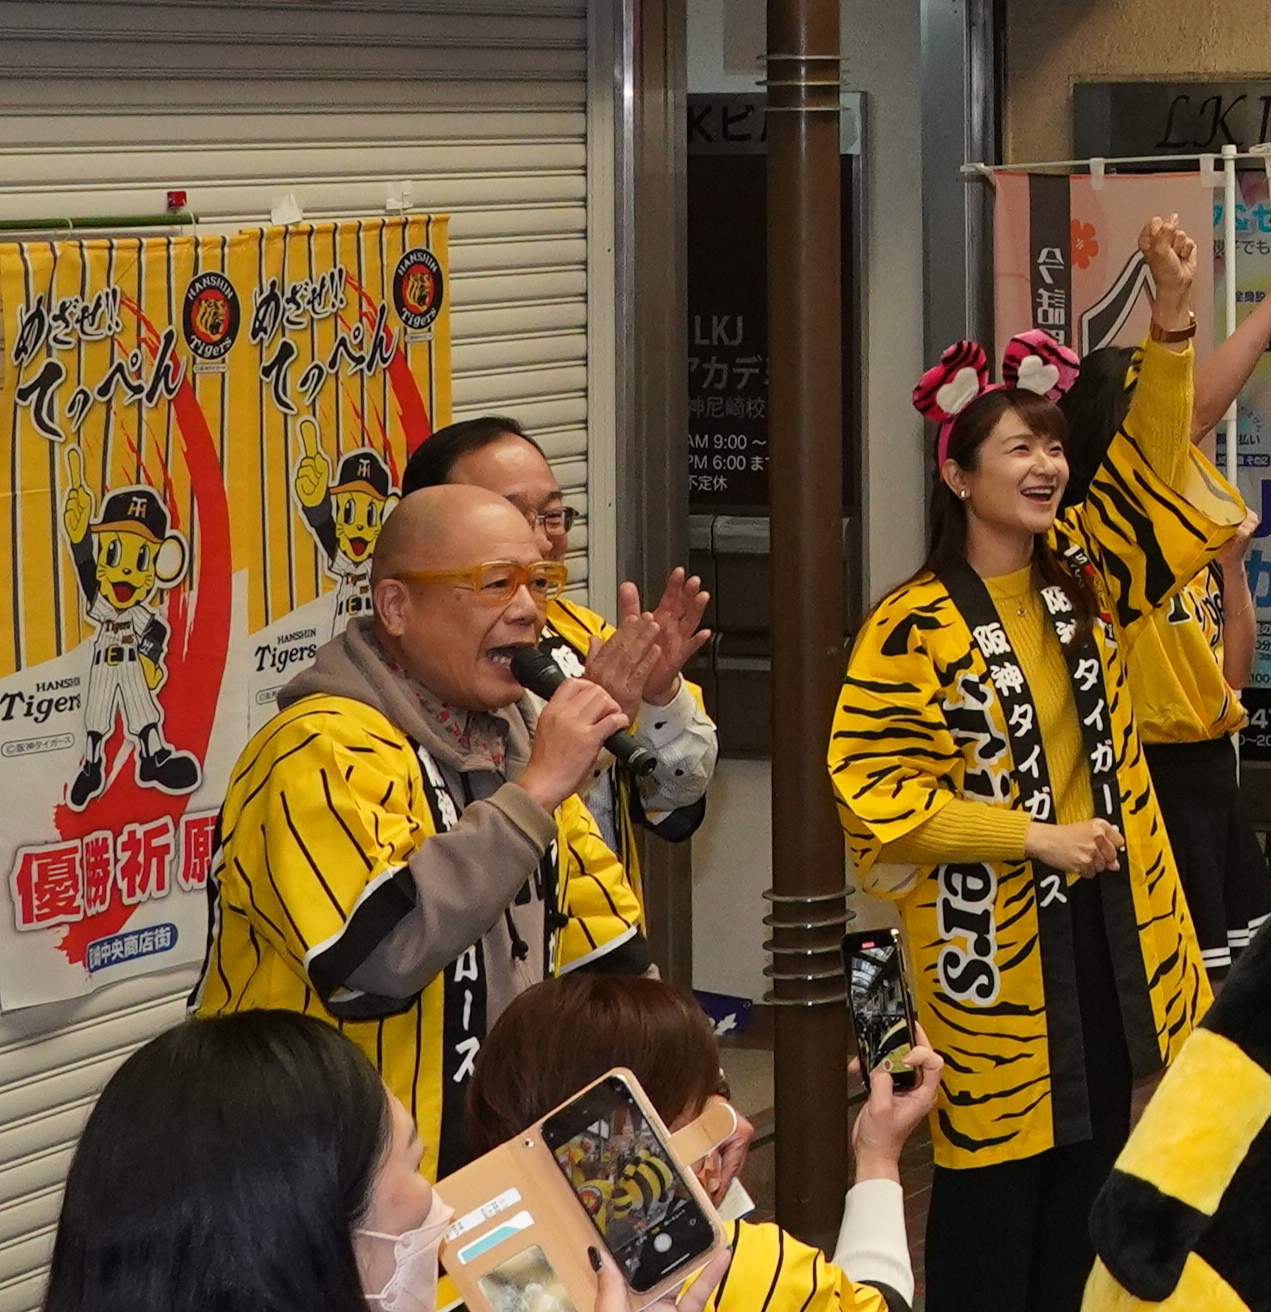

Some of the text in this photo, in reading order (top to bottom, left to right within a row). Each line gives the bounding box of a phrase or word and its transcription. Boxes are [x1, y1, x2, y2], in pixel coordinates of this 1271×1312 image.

[397, 251, 438, 275] HANSHIN
[188, 276, 235, 299] HANSHIN
[252, 265, 346, 341] めざせ!!
[13, 288, 121, 363] めざせ!!
[400, 307, 436, 329] Tigers
[694, 314, 744, 347] LKJ
[189, 336, 234, 359] Tigers
[262, 303, 397, 412] てっぺん
[17, 328, 187, 439] てっぺん
[713, 435, 747, 451] 9:00
[713, 455, 747, 471] 6:00
[277, 628, 316, 645] HANSHIN
[255, 643, 316, 671] Tigers
[974, 625, 1068, 907] 阪神タイガス
